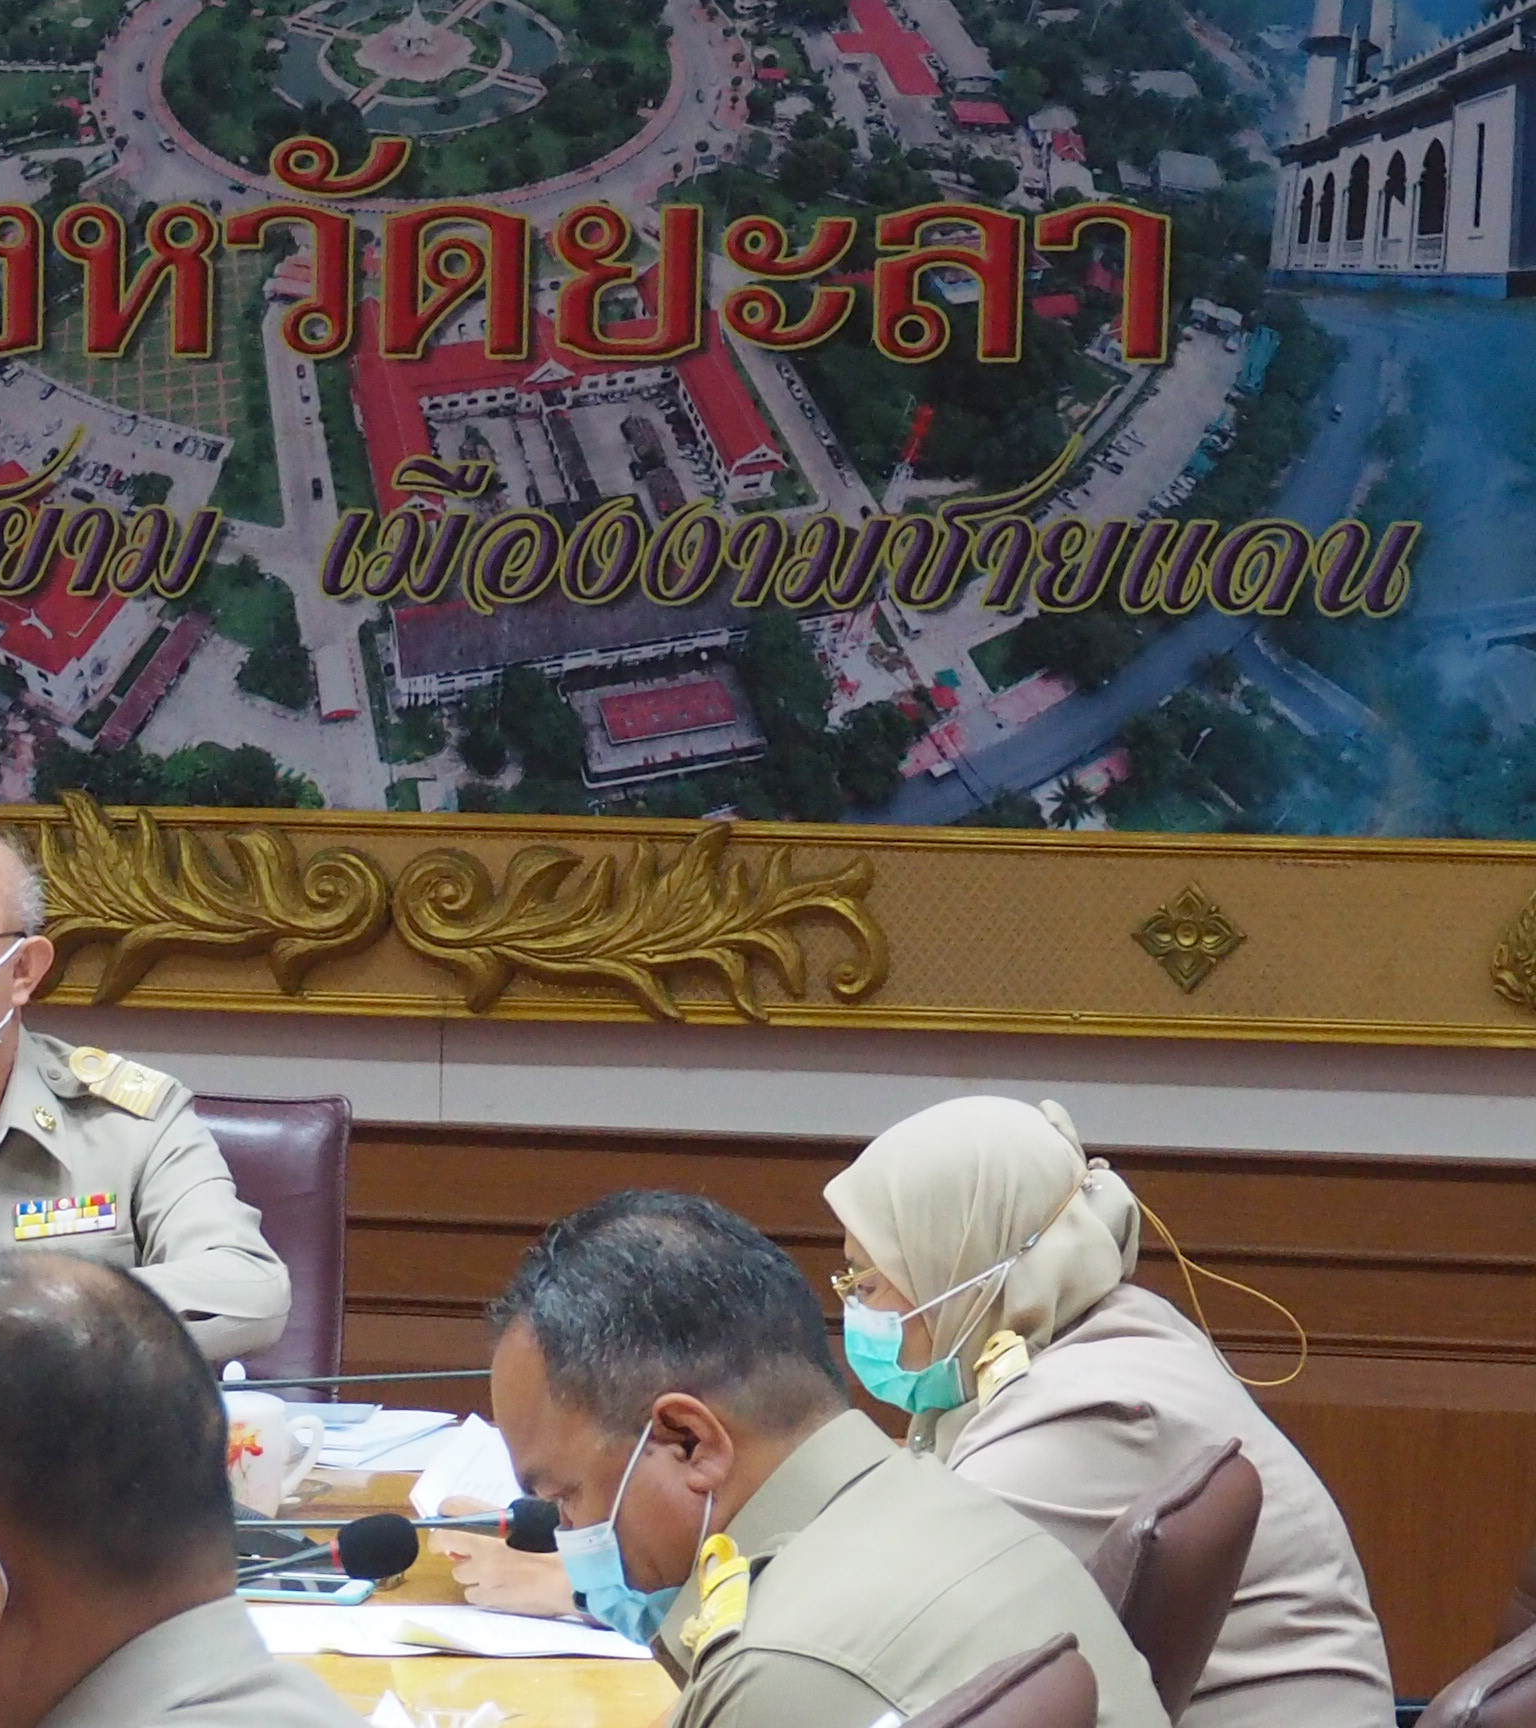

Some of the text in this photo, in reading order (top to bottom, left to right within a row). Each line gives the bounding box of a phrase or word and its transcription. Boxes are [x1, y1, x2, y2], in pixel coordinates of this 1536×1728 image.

[319, 431, 1422, 616] เมืองงามชายแดน
